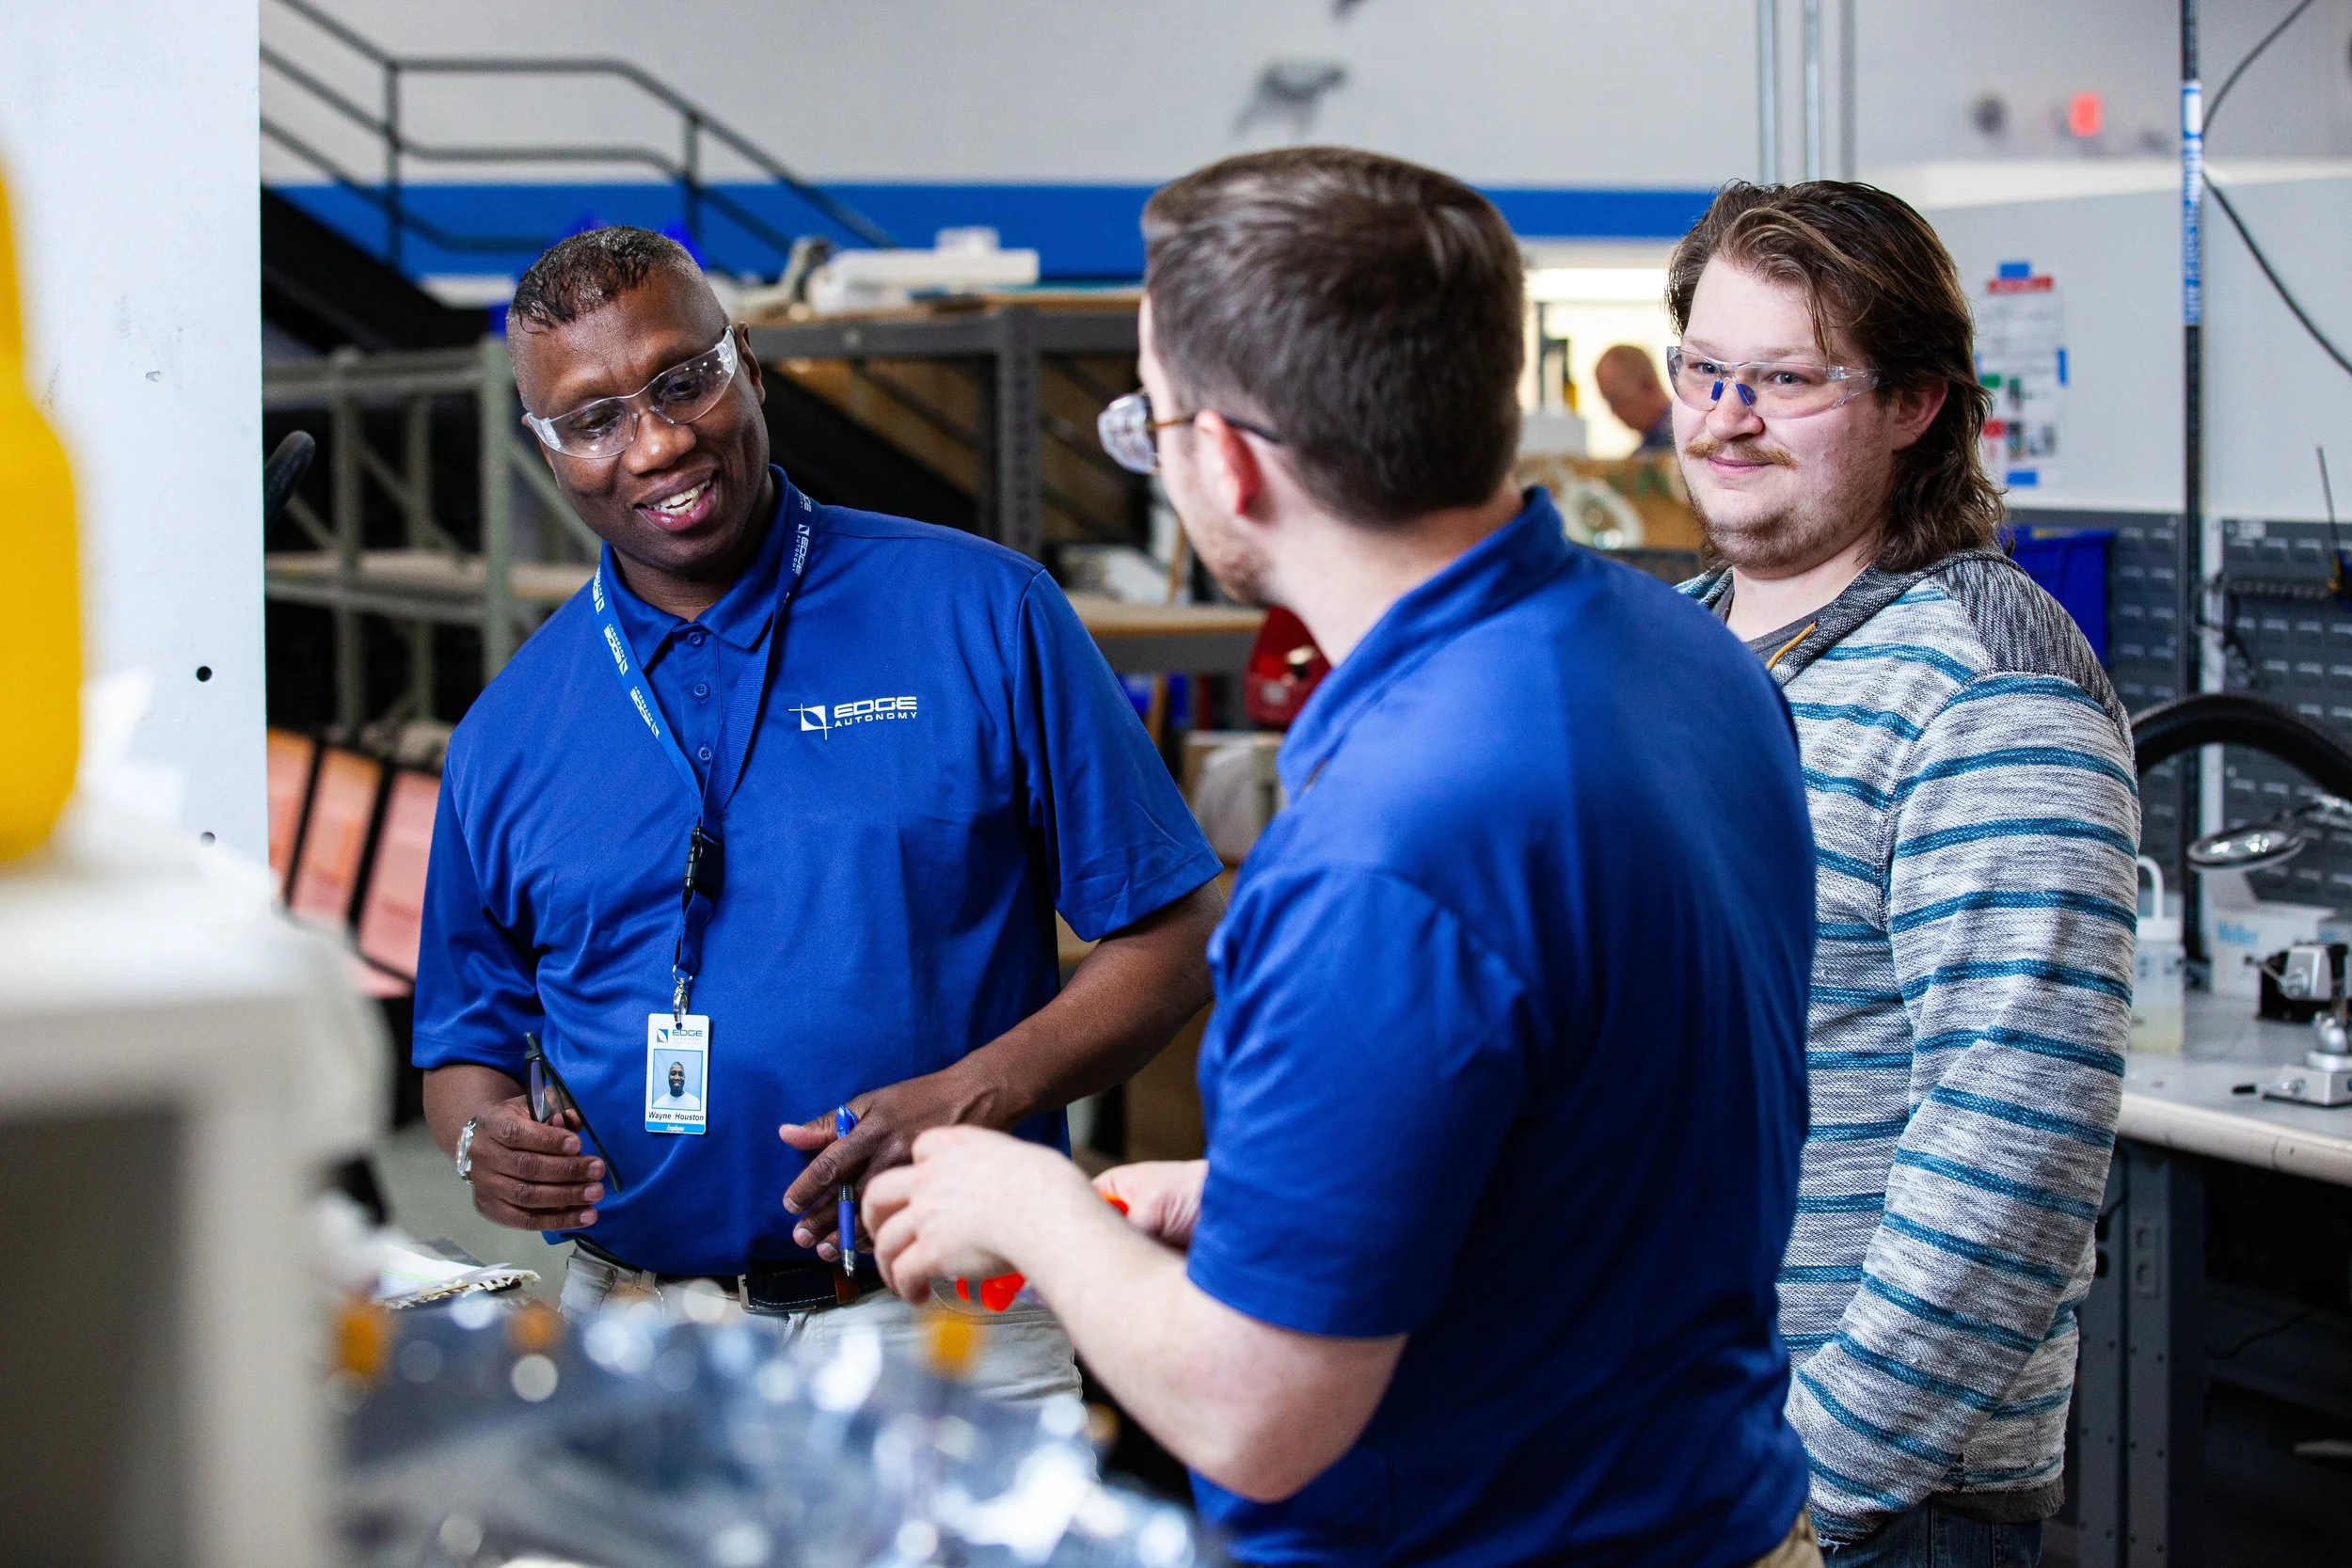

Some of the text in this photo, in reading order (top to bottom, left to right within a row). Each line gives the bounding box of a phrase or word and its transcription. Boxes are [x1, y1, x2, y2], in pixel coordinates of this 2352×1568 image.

[791, 535, 801, 572] AUTONOMY
[795, 536, 809, 577] EDGE
[834, 696, 918, 719] EDGE
[834, 711, 917, 728] AUTONOMY
[648, 1111, 672, 1120] Wayne
